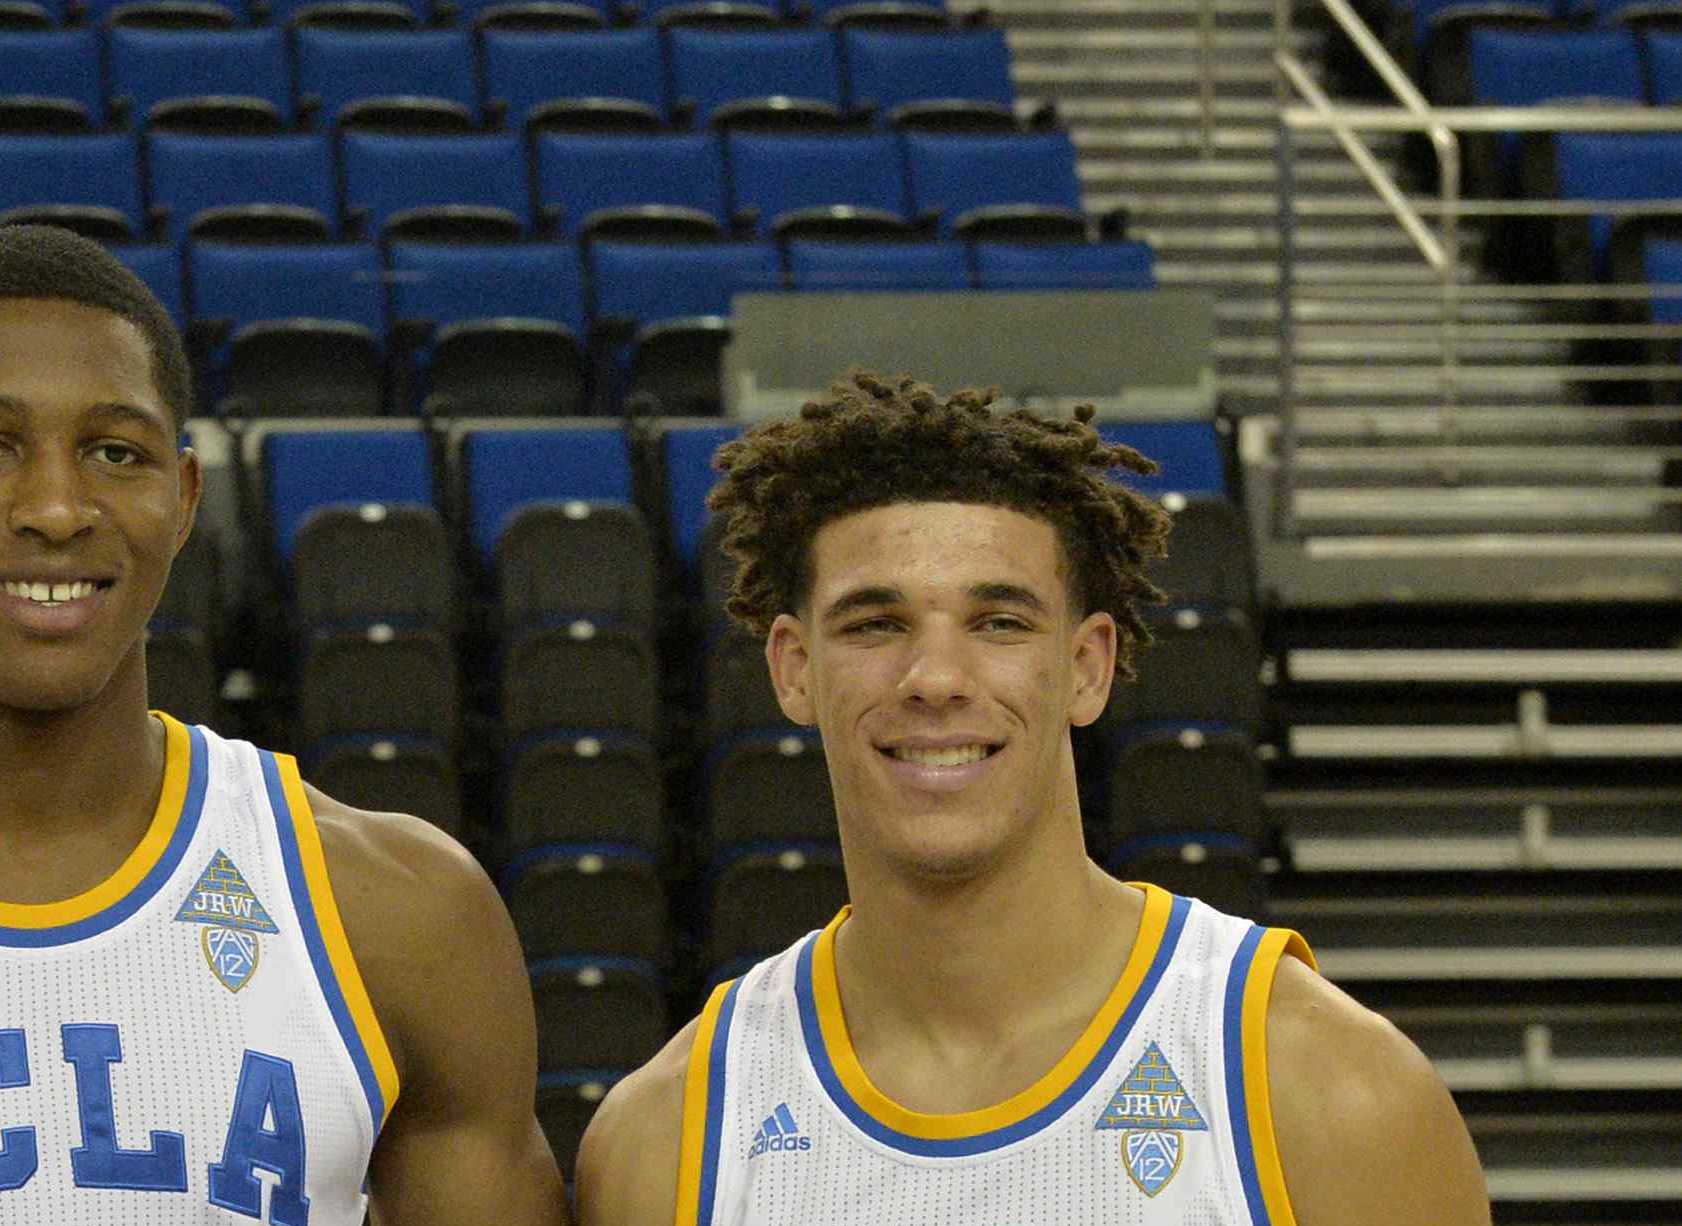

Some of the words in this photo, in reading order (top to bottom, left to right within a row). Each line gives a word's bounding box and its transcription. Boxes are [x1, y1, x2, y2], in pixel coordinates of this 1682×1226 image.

[193, 892, 255, 918] JRW
[219, 953, 246, 977] 12
[1116, 1093, 1185, 1118] JRW
[1138, 1157, 1165, 1181] 12
